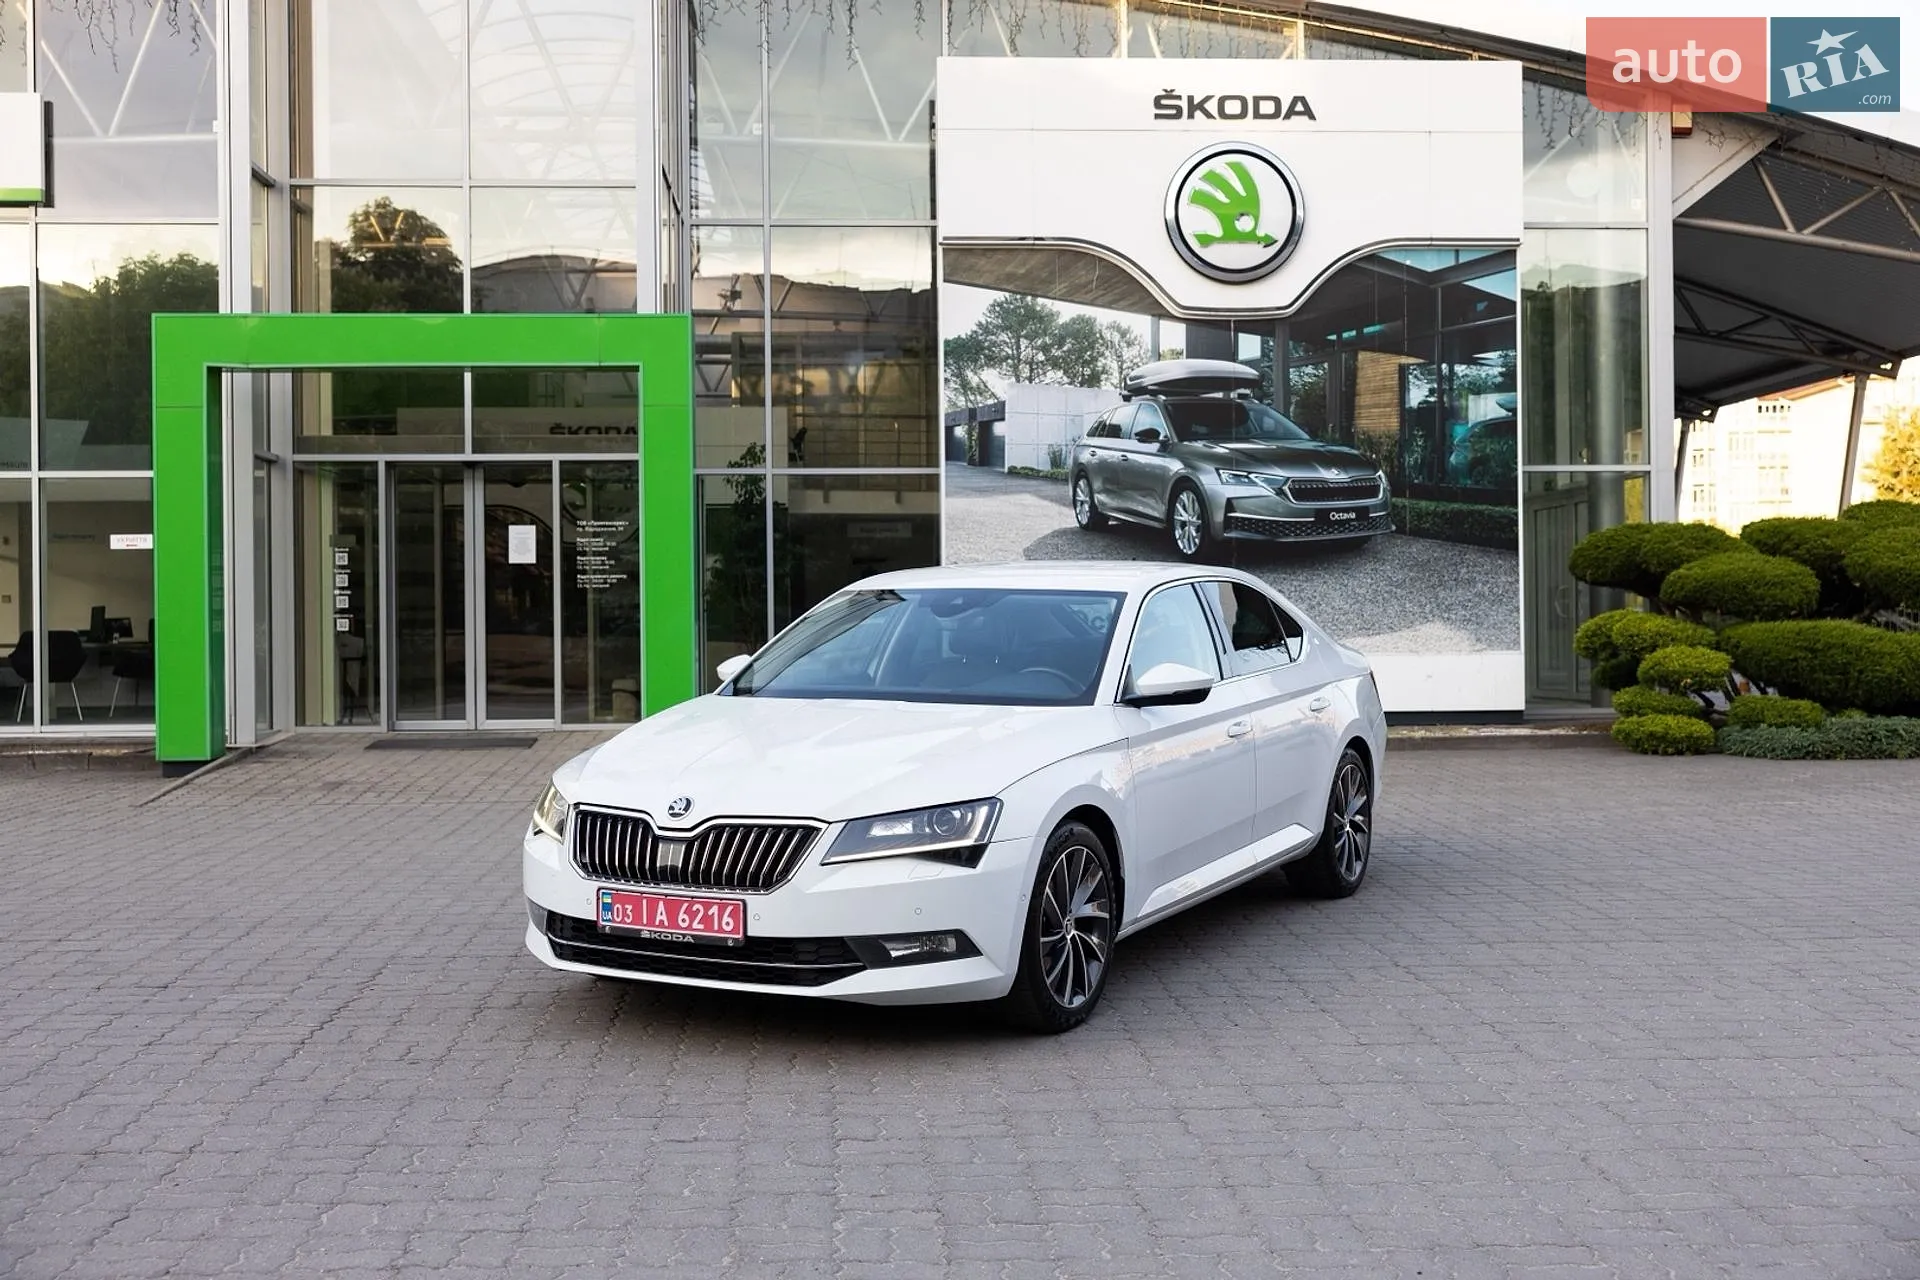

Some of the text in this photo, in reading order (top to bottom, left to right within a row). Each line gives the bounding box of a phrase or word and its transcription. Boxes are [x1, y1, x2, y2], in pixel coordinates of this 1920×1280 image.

[1153, 88, 1317, 121] ŠKODA
[1329, 511, 1356, 521] Octavia
[602, 911, 613, 920] UA
[613, 903, 633, 924] 03
[677, 902, 736, 932] 6216
[639, 930, 696, 943] ŠKODA
